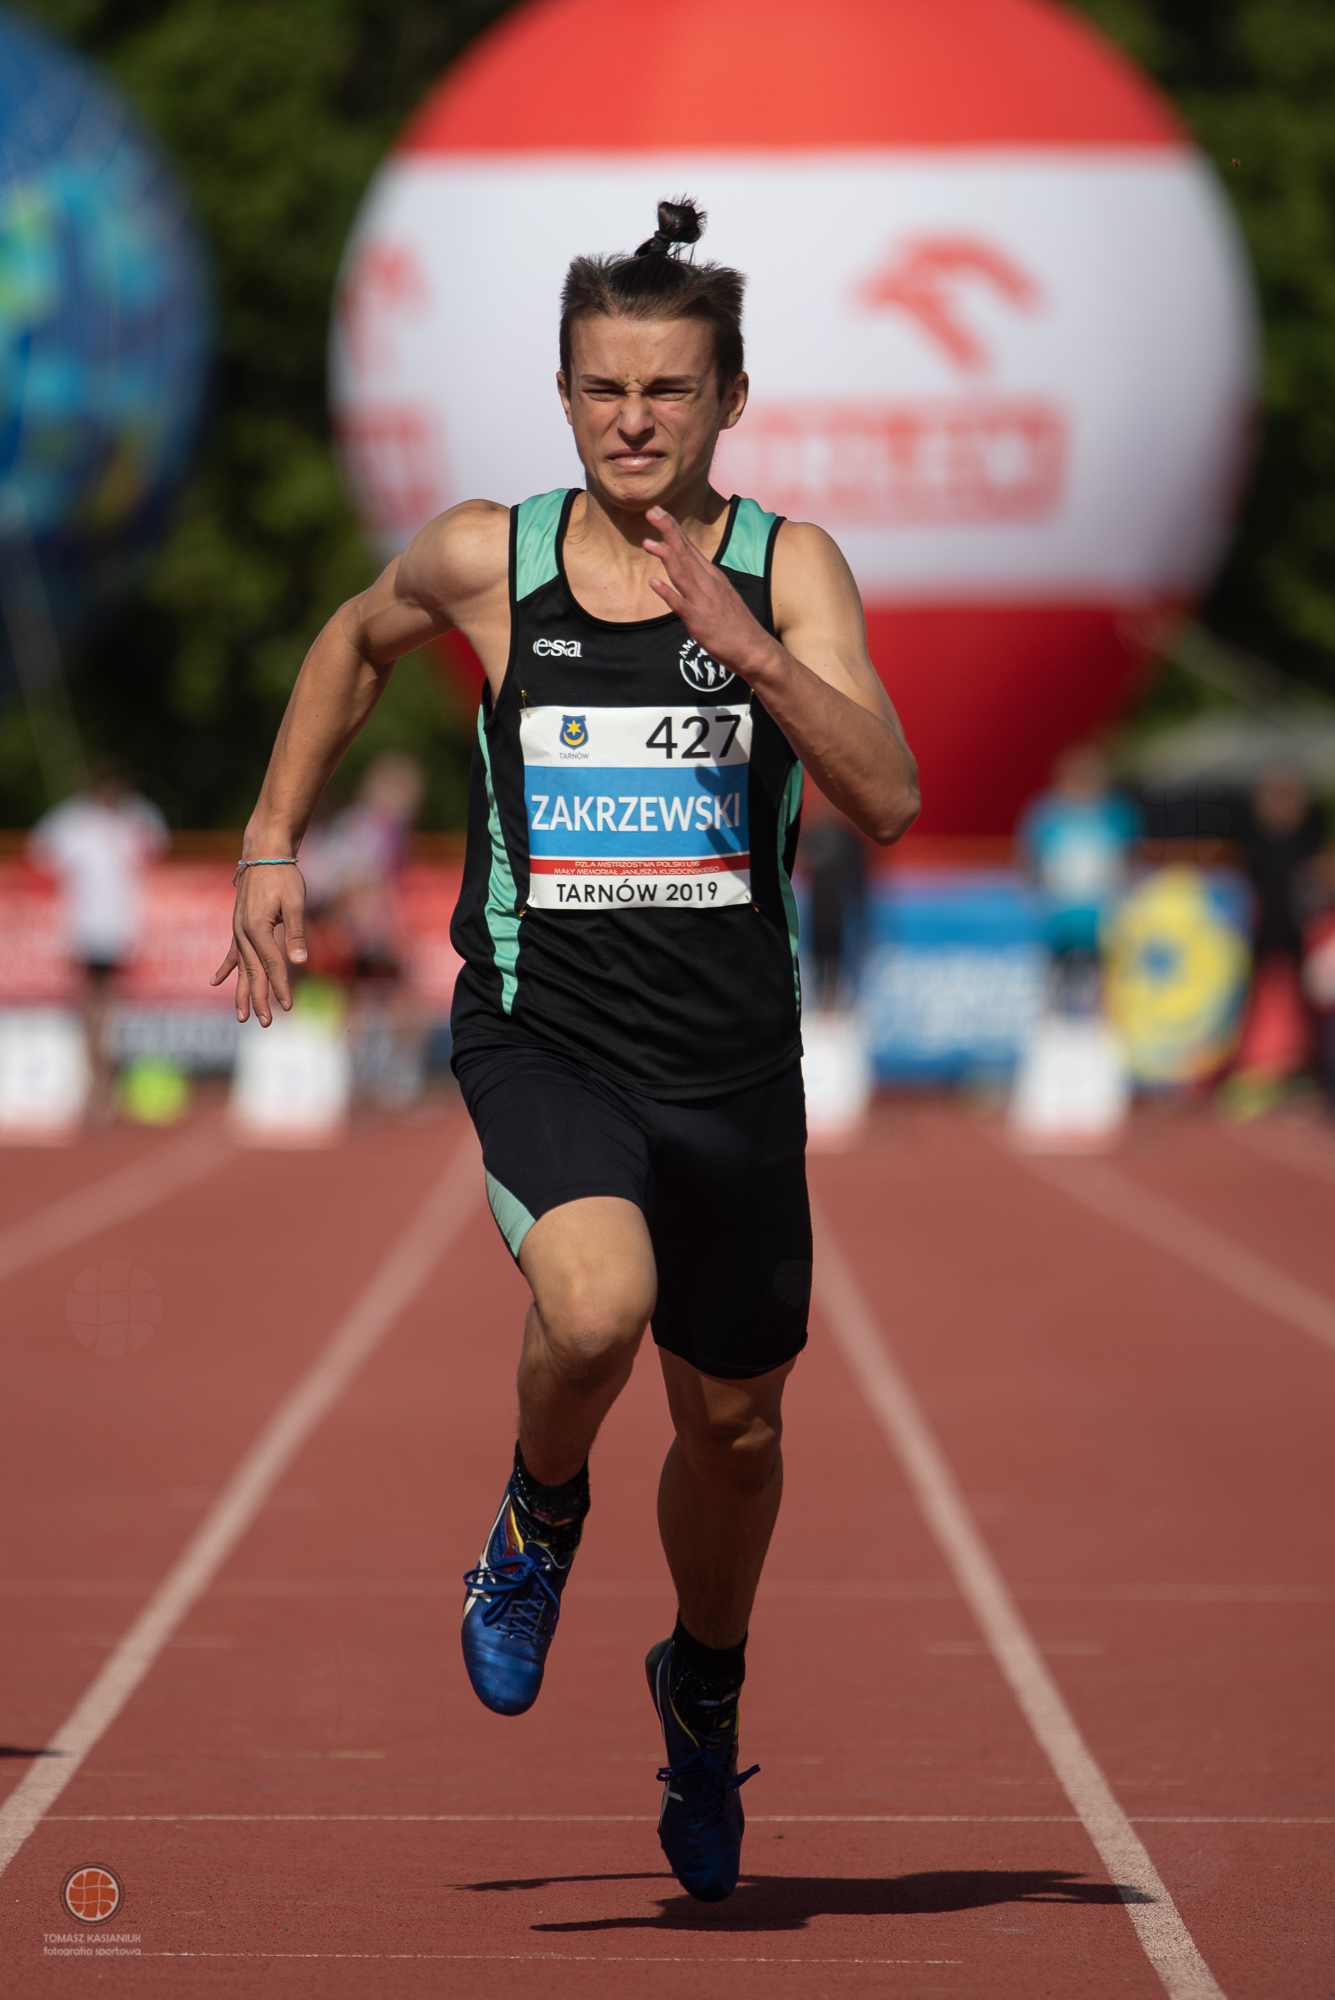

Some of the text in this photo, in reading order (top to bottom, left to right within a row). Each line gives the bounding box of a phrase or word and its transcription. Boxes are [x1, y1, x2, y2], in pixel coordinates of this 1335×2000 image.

[533, 638, 582, 657] esa
[645, 714, 741, 760] 427
[558, 751, 590, 760] TARNÓW
[531, 793, 740, 832] ZAKRZEWSKI
[556, 879, 718, 903] TARNÓW 2019
